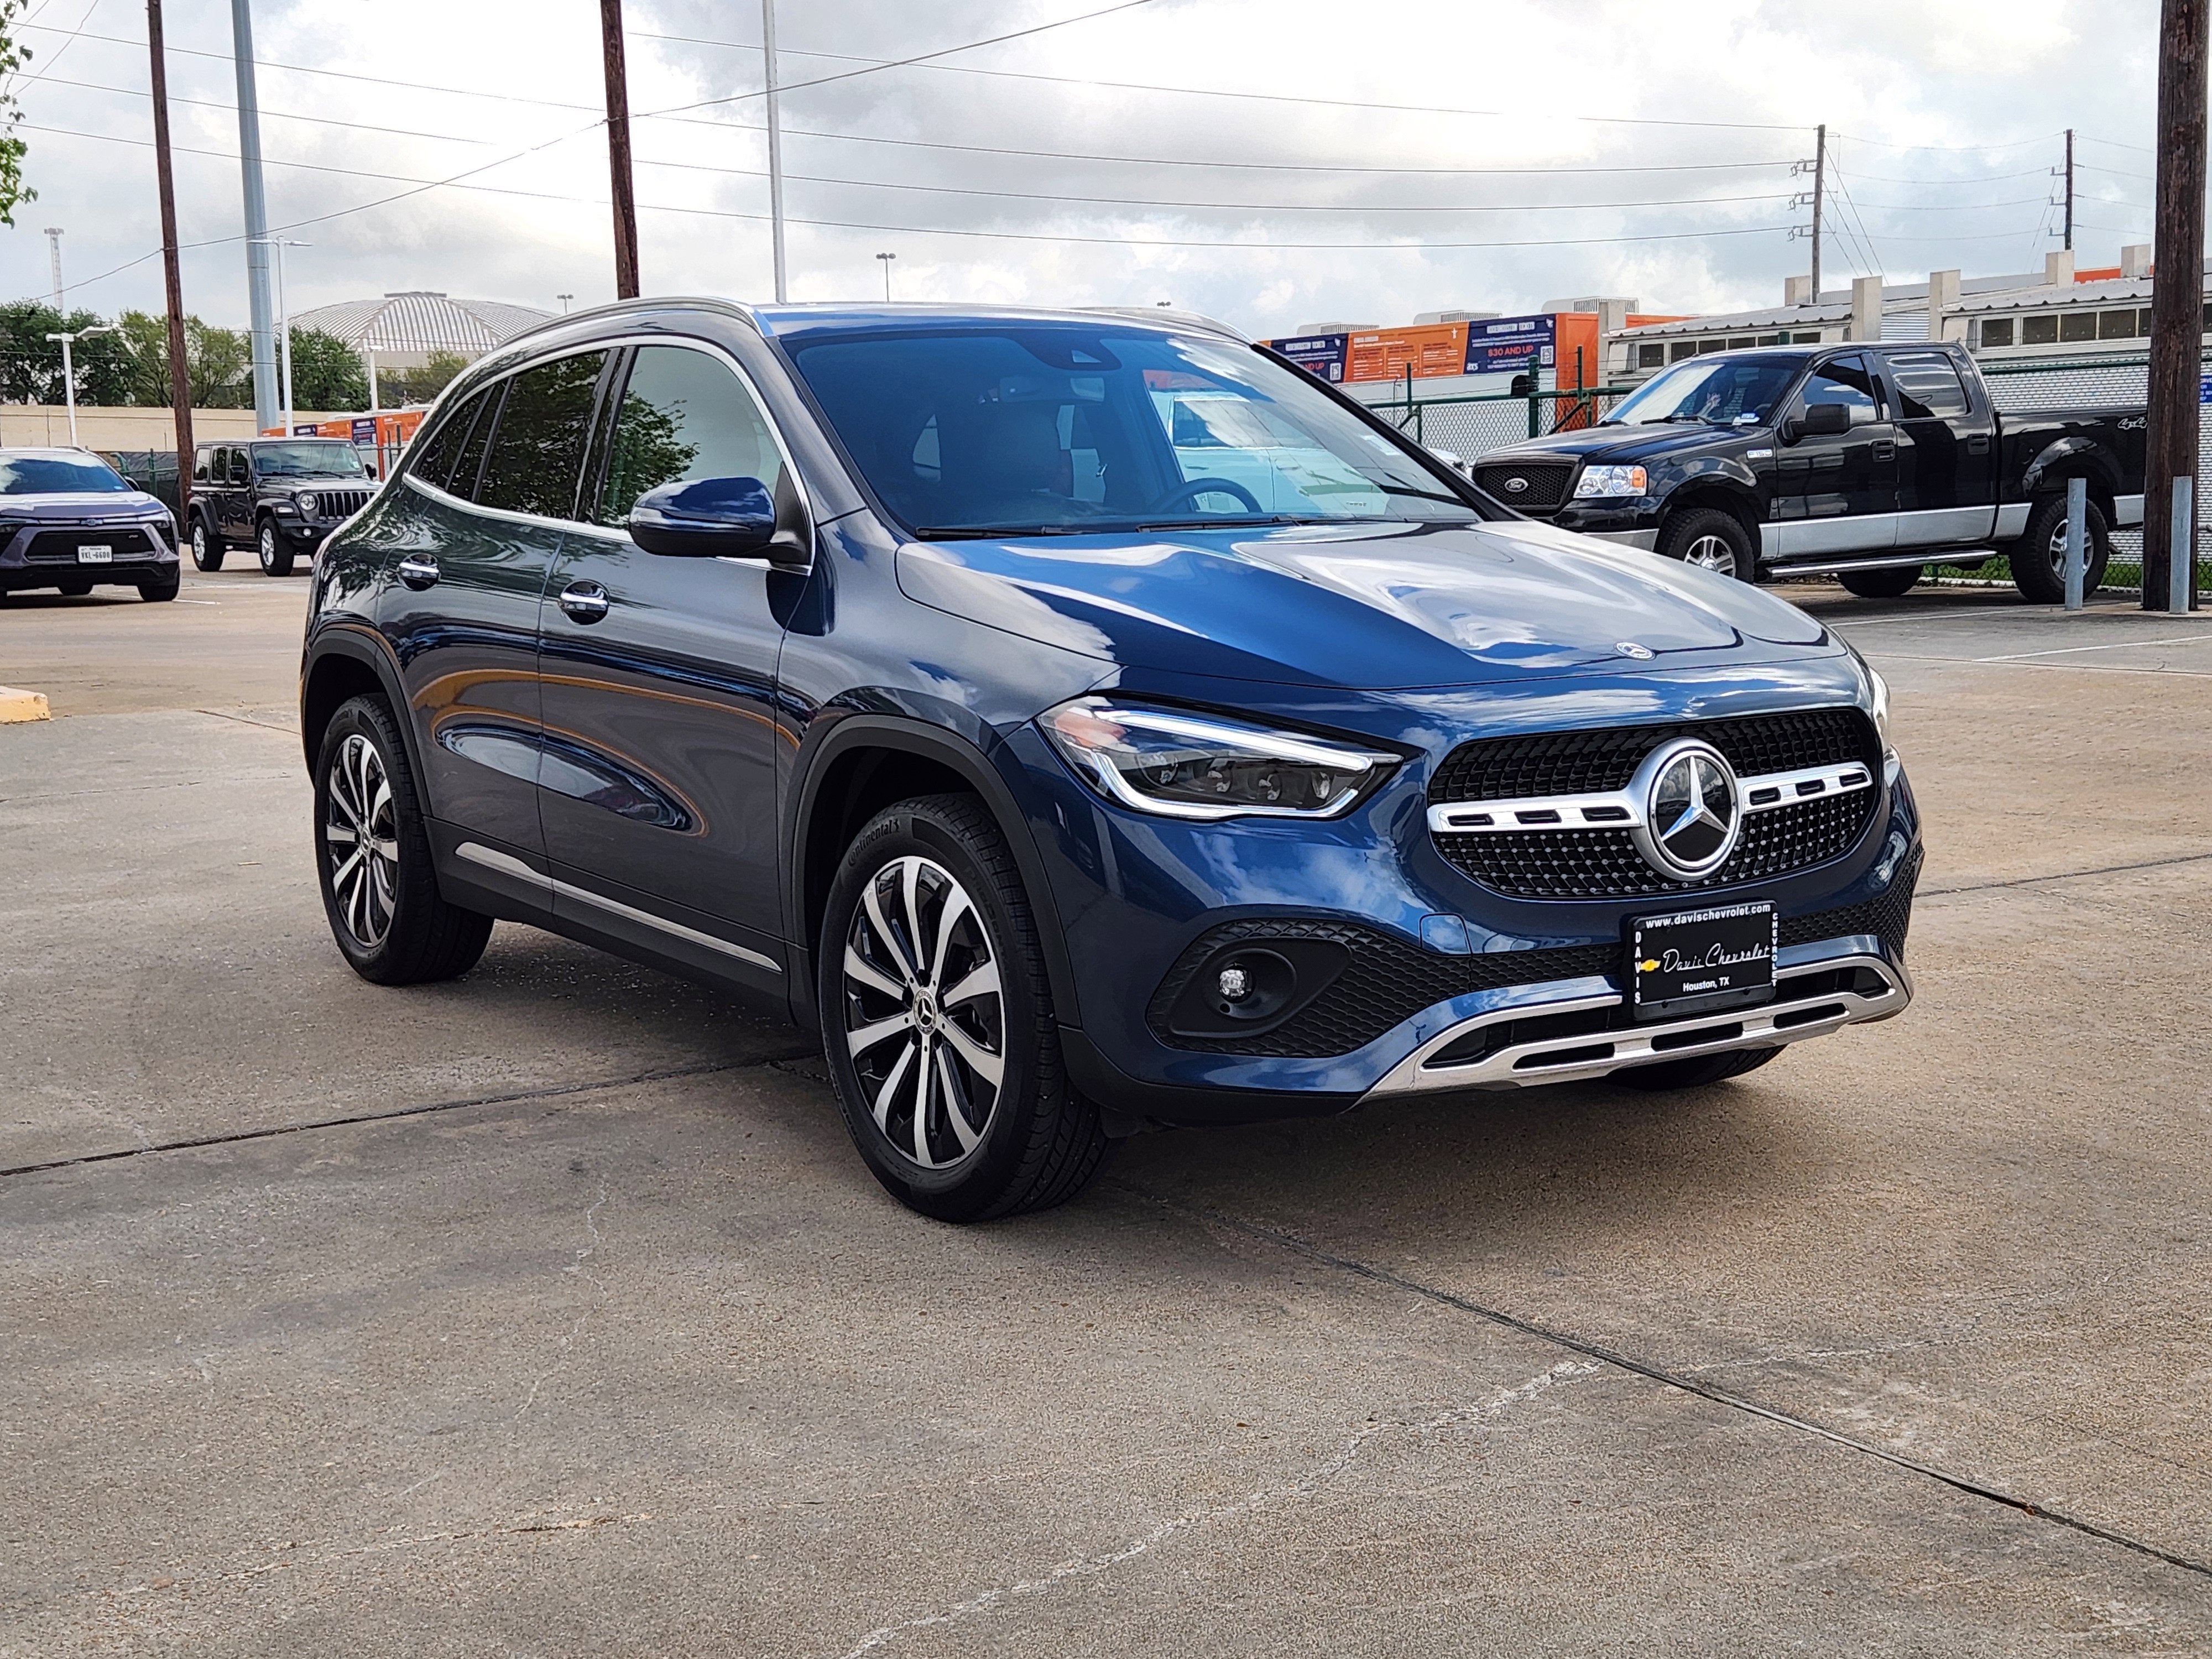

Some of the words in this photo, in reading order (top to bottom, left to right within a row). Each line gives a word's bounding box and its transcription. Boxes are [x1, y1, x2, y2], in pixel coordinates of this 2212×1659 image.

[1505, 347, 1521, 355] AND
[1522, 345, 1533, 353] UP
[847, 819, 892, 867] Continental
[1646, 904, 1771, 929] www.davischevrolet.com
[1663, 948, 1704, 973] Davis
[1705, 943, 1771, 967] Chevrolet
[1683, 979, 1717, 992] Houston,
[1719, 976, 1730, 986] TX
